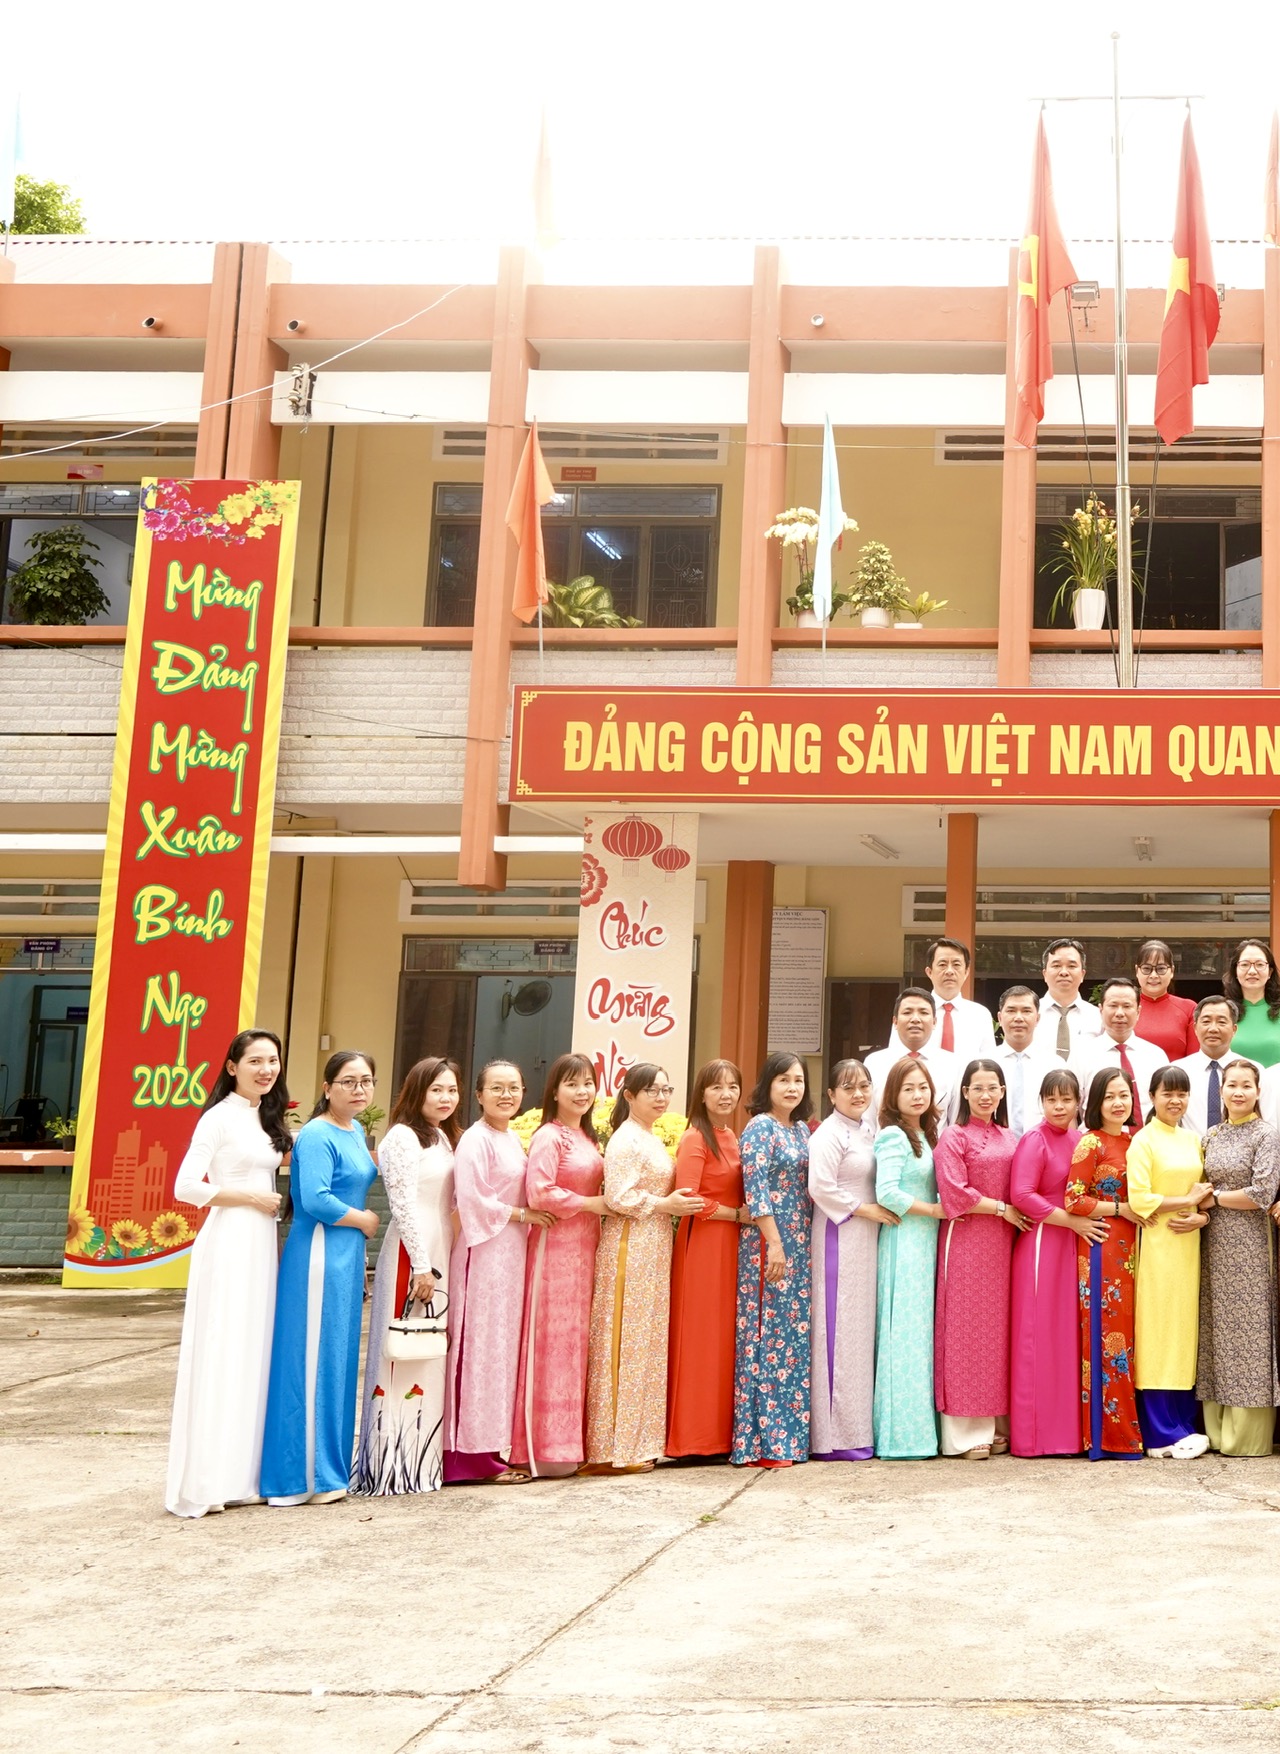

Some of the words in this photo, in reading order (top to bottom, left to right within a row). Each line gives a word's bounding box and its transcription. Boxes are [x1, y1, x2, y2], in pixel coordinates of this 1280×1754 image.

[165, 560, 263, 652] Mừng
[152, 641, 258, 733] Đảng
[148, 722, 249, 815] Mừng
[563, 703, 686, 772] ĐẢNG
[701, 711, 822, 785] CỘNG
[837, 705, 929, 775] SẢN
[943, 712, 1036, 787] VIỆT
[1050, 724, 1152, 775] NAM
[136, 801, 243, 860] Xuân
[134, 885, 234, 945] Bính
[600, 900, 667, 951] Chúc
[141, 971, 209, 1068] Ngọ
[588, 978, 675, 1037] Mừng
[133, 1062, 210, 1108] 2026
[594, 1040, 637, 1097] Nă
